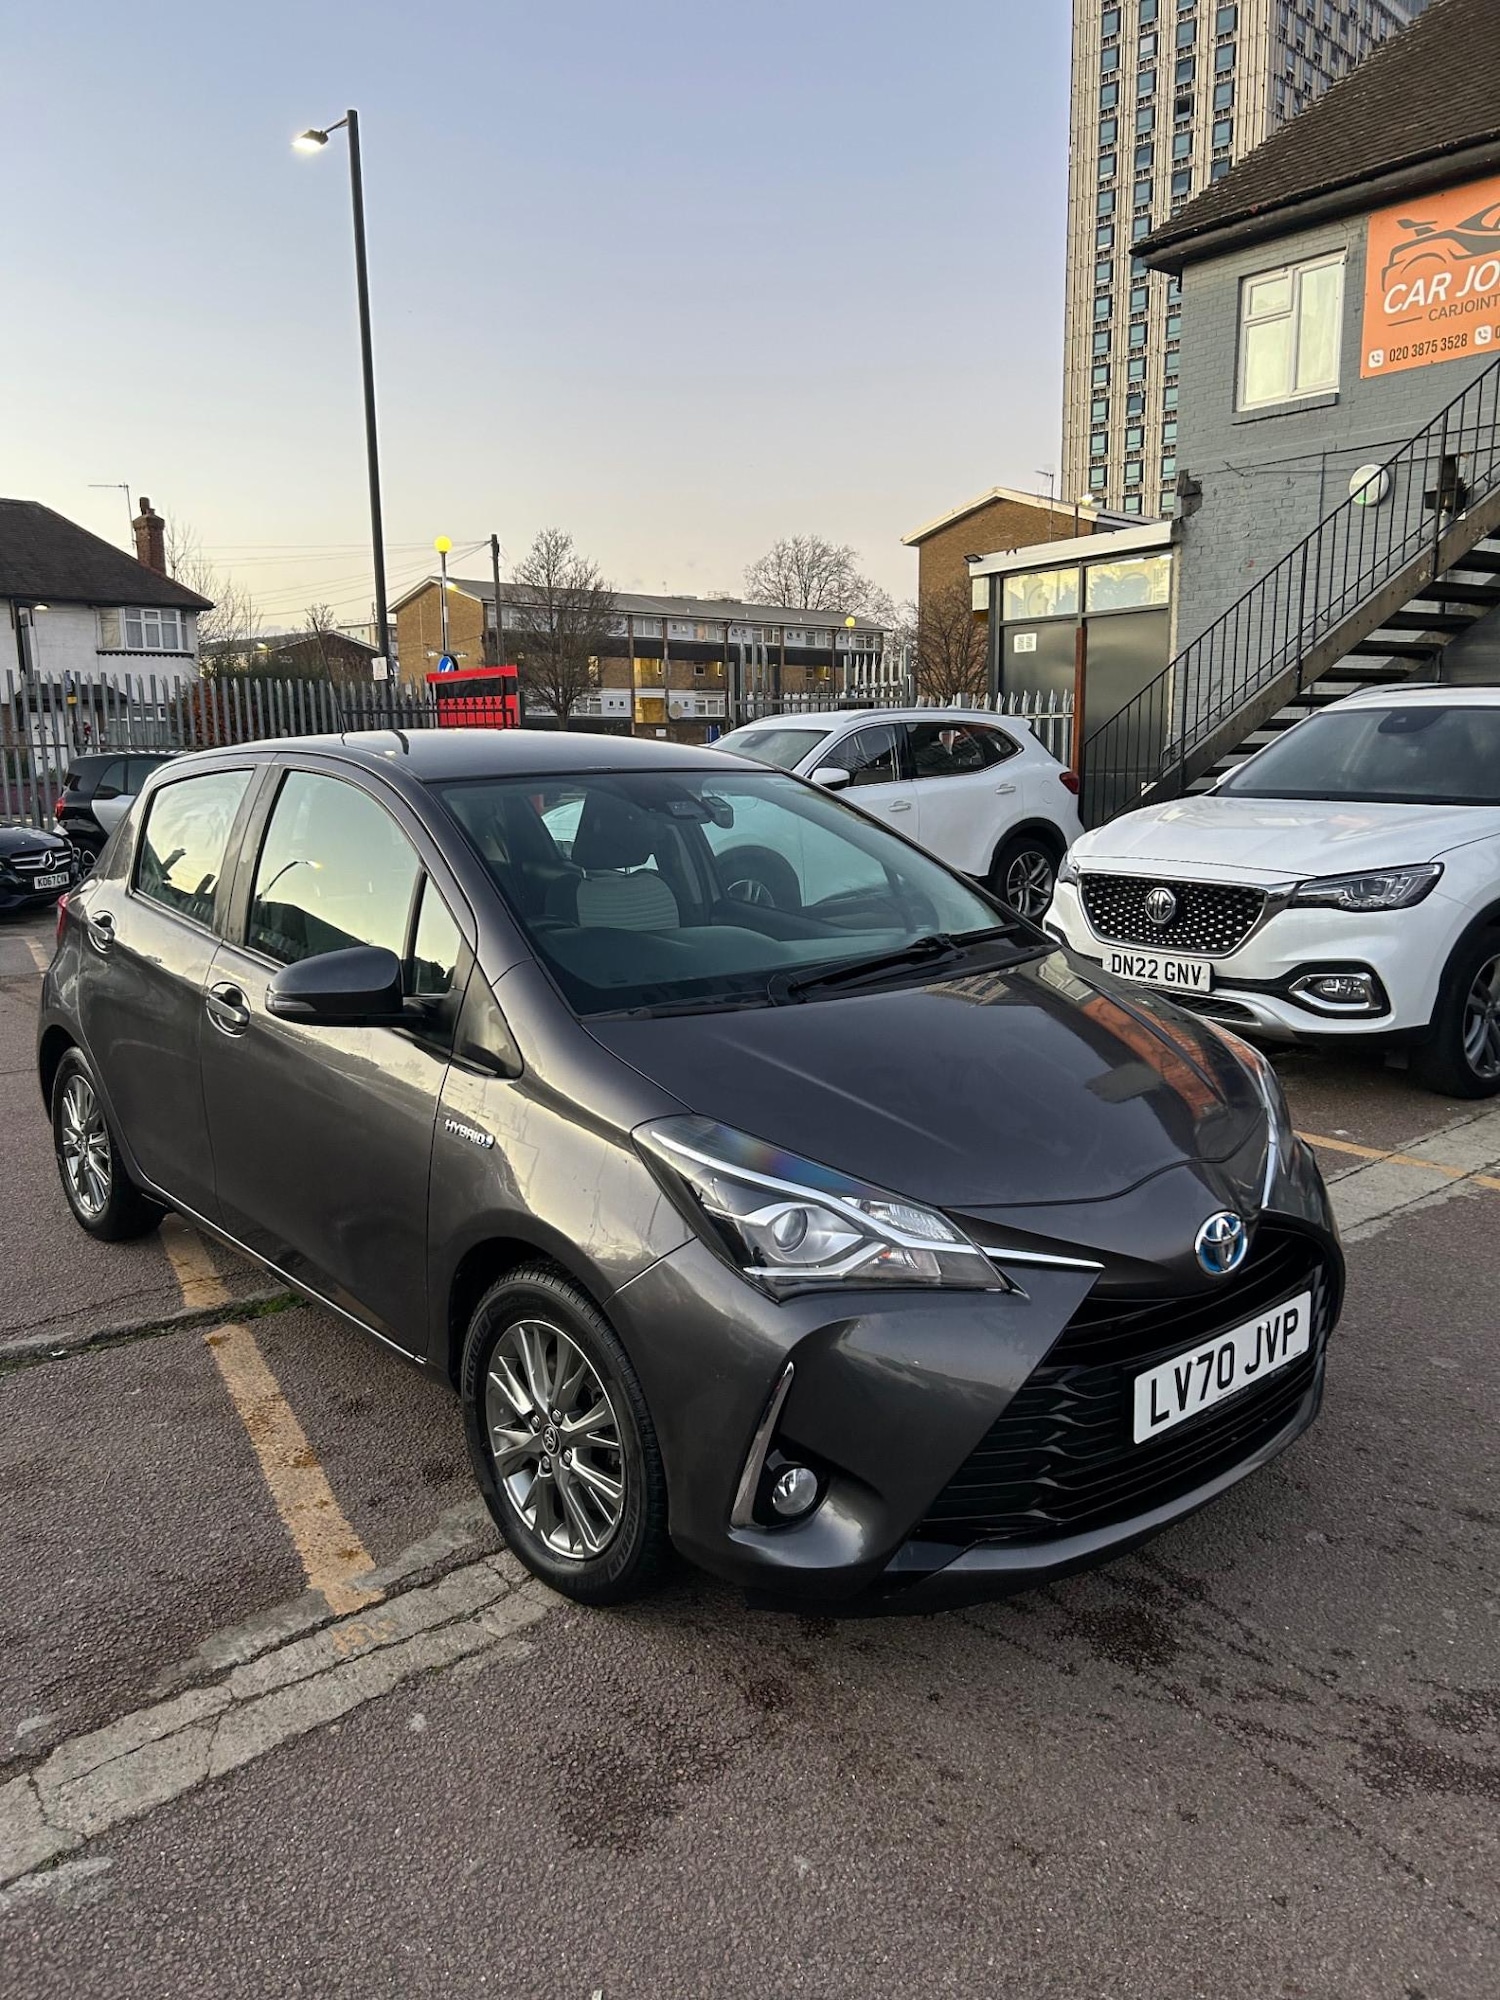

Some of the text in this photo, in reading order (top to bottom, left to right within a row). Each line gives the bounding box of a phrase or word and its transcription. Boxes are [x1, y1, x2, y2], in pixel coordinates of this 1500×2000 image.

[1383, 272, 1452, 314] CAR
[1428, 293, 1500, 321] CARJOINT
[1389, 333, 1468, 362] 020 3875 3528
[1148, 890, 1172, 920] MG
[1111, 953, 1202, 986] DN22 GNV
[445, 1119, 486, 1146] HYBRID
[1150, 1307, 1299, 1427] LV70 JVP
